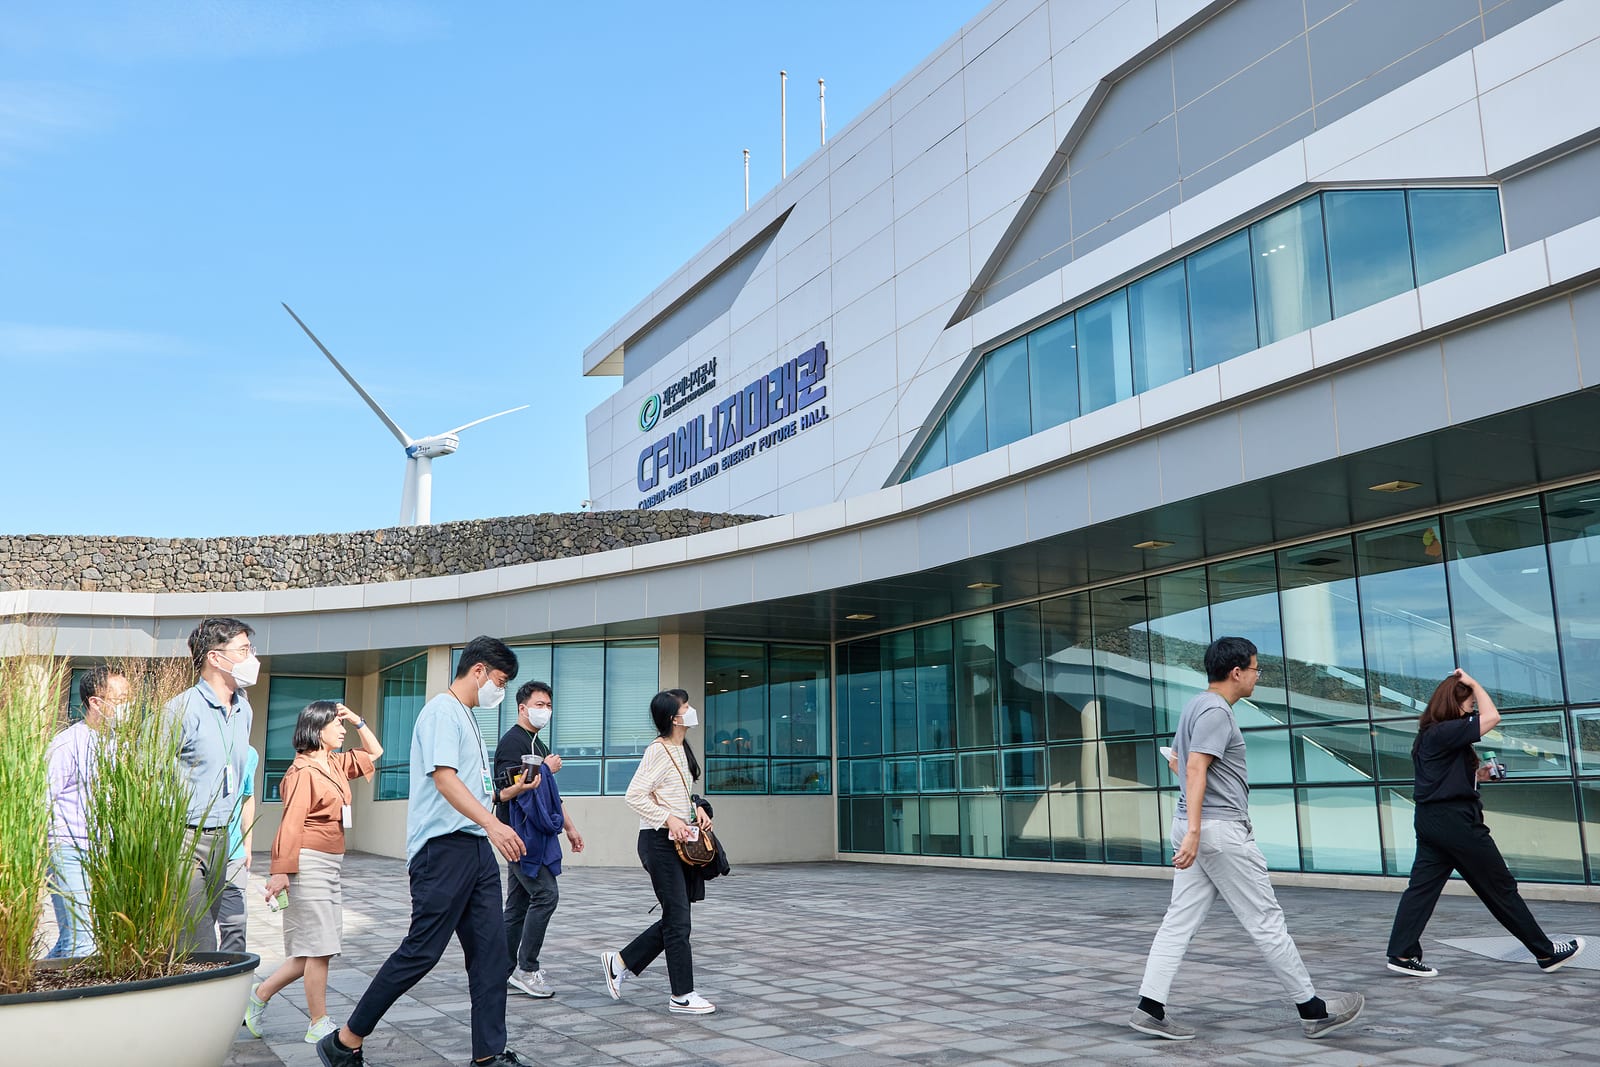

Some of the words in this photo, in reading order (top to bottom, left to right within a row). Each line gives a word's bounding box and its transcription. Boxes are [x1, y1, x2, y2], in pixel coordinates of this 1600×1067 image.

[663, 357, 717, 406] 제주에너지공사
[638, 477, 688, 510] CARBON-FREE
[689, 462, 719, 488] ISLAND
[721, 441, 757, 470] ENERGY
[758, 420, 797, 452] FUTURE
[800, 405, 829, 431] HALL
